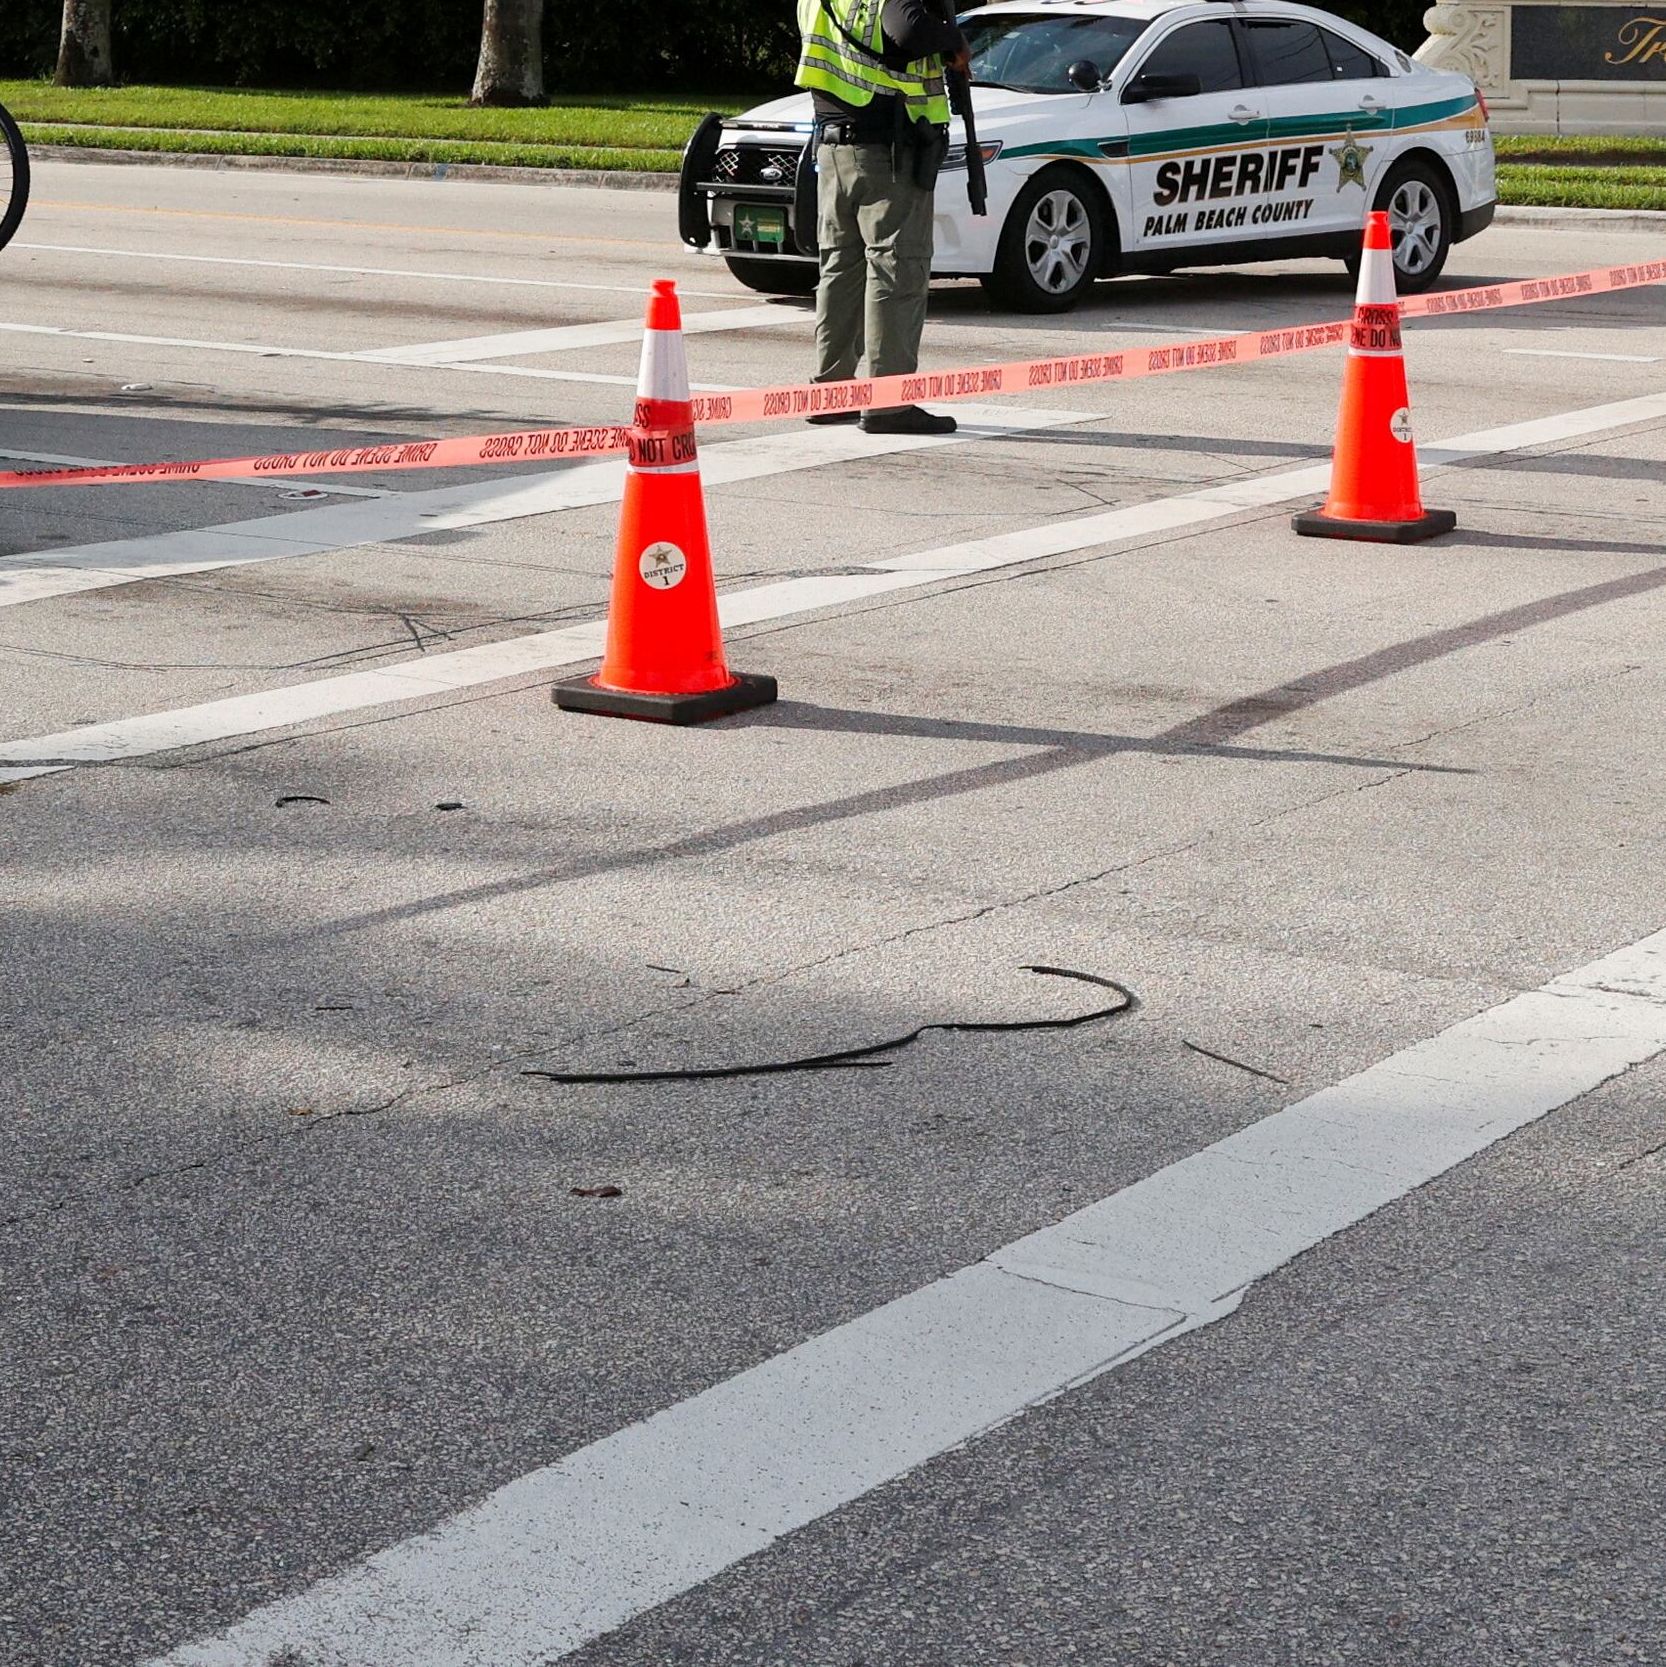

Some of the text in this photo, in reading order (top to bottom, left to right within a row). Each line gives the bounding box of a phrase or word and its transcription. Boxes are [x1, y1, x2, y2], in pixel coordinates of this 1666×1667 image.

[1152, 144, 1324, 207] SHERIFF
[1143, 199, 1315, 238] PALM BEACH COUNTY
[638, 437, 666, 463] NOT
[644, 564, 684, 579] DISTRICT
[663, 576, 670, 586] 1
